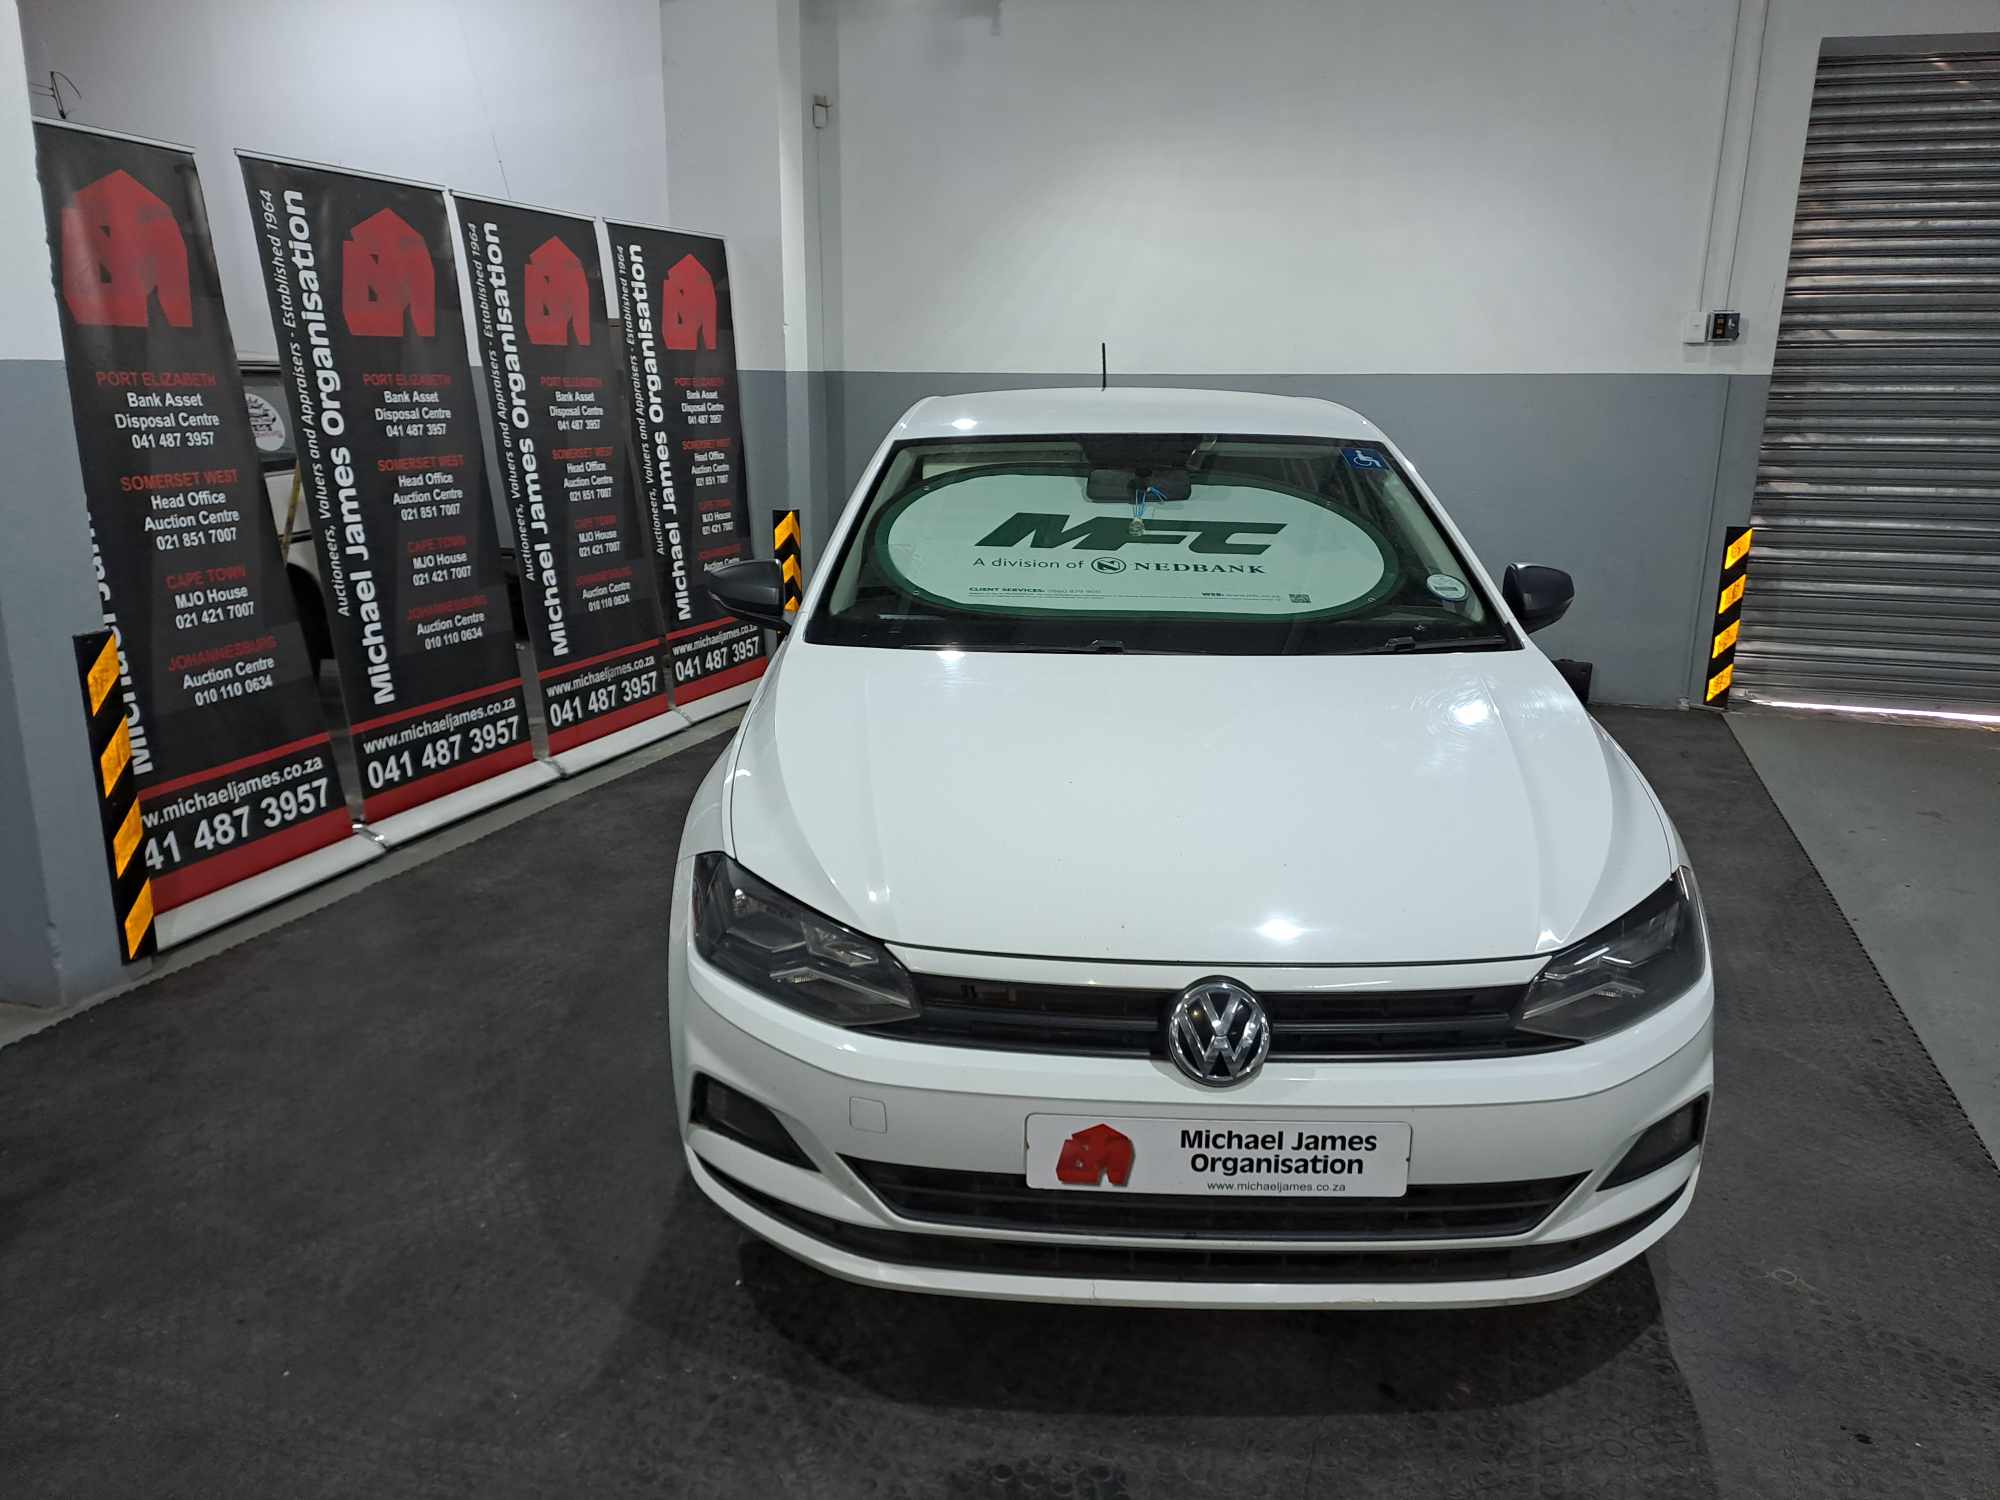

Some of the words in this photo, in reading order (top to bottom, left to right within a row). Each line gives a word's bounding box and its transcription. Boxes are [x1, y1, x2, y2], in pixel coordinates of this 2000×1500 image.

[259, 189, 278, 229] 1964
[467, 222, 480, 257] 1964
[267, 235, 296, 328] Established
[283, 190, 345, 436] Organisation
[472, 259, 494, 338] Established
[96, 371, 138, 386] PORT
[289, 342, 315, 426] Appraisers
[488, 349, 507, 419] Appraisers
[127, 392, 162, 408] Bank
[165, 392, 203, 407] Asset
[384, 391, 410, 403] Bank
[412, 391, 439, 403] Asset
[114, 413, 175, 430] Disposal
[179, 412, 220, 426] Centre
[375, 408, 420, 422] Disposal
[421, 407, 452, 419] Centre
[386, 425, 404, 437] 041
[638, 418, 649, 439] and
[131, 433, 156, 449] 041
[159, 433, 181, 448] 487
[187, 432, 215, 446] 3957
[302, 427, 320, 460] and
[499, 422, 513, 448] and
[506, 451, 521, 499] Valuers
[642, 442, 654, 484] Valuers
[654, 431, 677, 515] James
[120, 471, 200, 491] SOMERSET
[205, 469, 239, 485] WEST
[312, 466, 332, 520] Valuers
[393, 491, 431, 505] Auction
[433, 488, 463, 500] Centre
[398, 475, 424, 488] Head
[425, 472, 454, 485] Office
[519, 438, 548, 534] James
[150, 493, 185, 510] Head
[187, 490, 227, 506] Office
[330, 446, 370, 562] James
[144, 514, 196, 531] Auction
[199, 509, 240, 525] Centre
[975, 512, 1288, 556] MFC
[156, 535, 180, 551] 021
[182, 531, 206, 547] 851
[209, 527, 237, 543] 7007
[515, 504, 535, 581] Auctioneers,
[325, 525, 350, 617] Auctioneers,
[413, 555, 434, 569] MJO
[436, 553, 467, 566] House
[664, 522, 692, 621] Michael
[973, 557, 985, 567] A
[992, 557, 1060, 569] division
[1066, 560, 1085, 569] of
[1135, 562, 1266, 574] NEDBANK
[175, 591, 204, 609] MJO
[206, 586, 248, 603] House
[534, 543, 569, 657] Michael
[175, 613, 198, 629] 021
[202, 607, 224, 624] 421
[227, 601, 255, 619] 7007
[417, 619, 453, 635] Auction
[455, 613, 485, 626] Centre
[350, 570, 395, 705] Michael
[183, 667, 233, 689] Auction
[235, 657, 275, 675] Centre
[675, 656, 701, 681] 041
[705, 647, 728, 671] 487
[732, 636, 759, 662] 3957
[195, 688, 217, 706] 010
[220, 682, 242, 701] 110
[550, 696, 582, 727] 041
[588, 684, 616, 712] 487
[621, 671, 657, 702] 3957
[363, 697, 516, 754] www.michaeljames.co.za
[367, 750, 413, 789] 041
[422, 734, 462, 768] 487
[469, 715, 519, 753] 3957
[142, 756, 324, 829] w.michaeljames.co.za
[144, 830, 182, 870] 41
[193, 805, 250, 851] 487
[260, 777, 329, 828] 3957
[1180, 1129, 1284, 1150] Michael
[1291, 1132, 1377, 1151] James
[1190, 1153, 1364, 1176] Organisation
[1207, 1180, 1346, 1193] www.michaeljames.co.za
